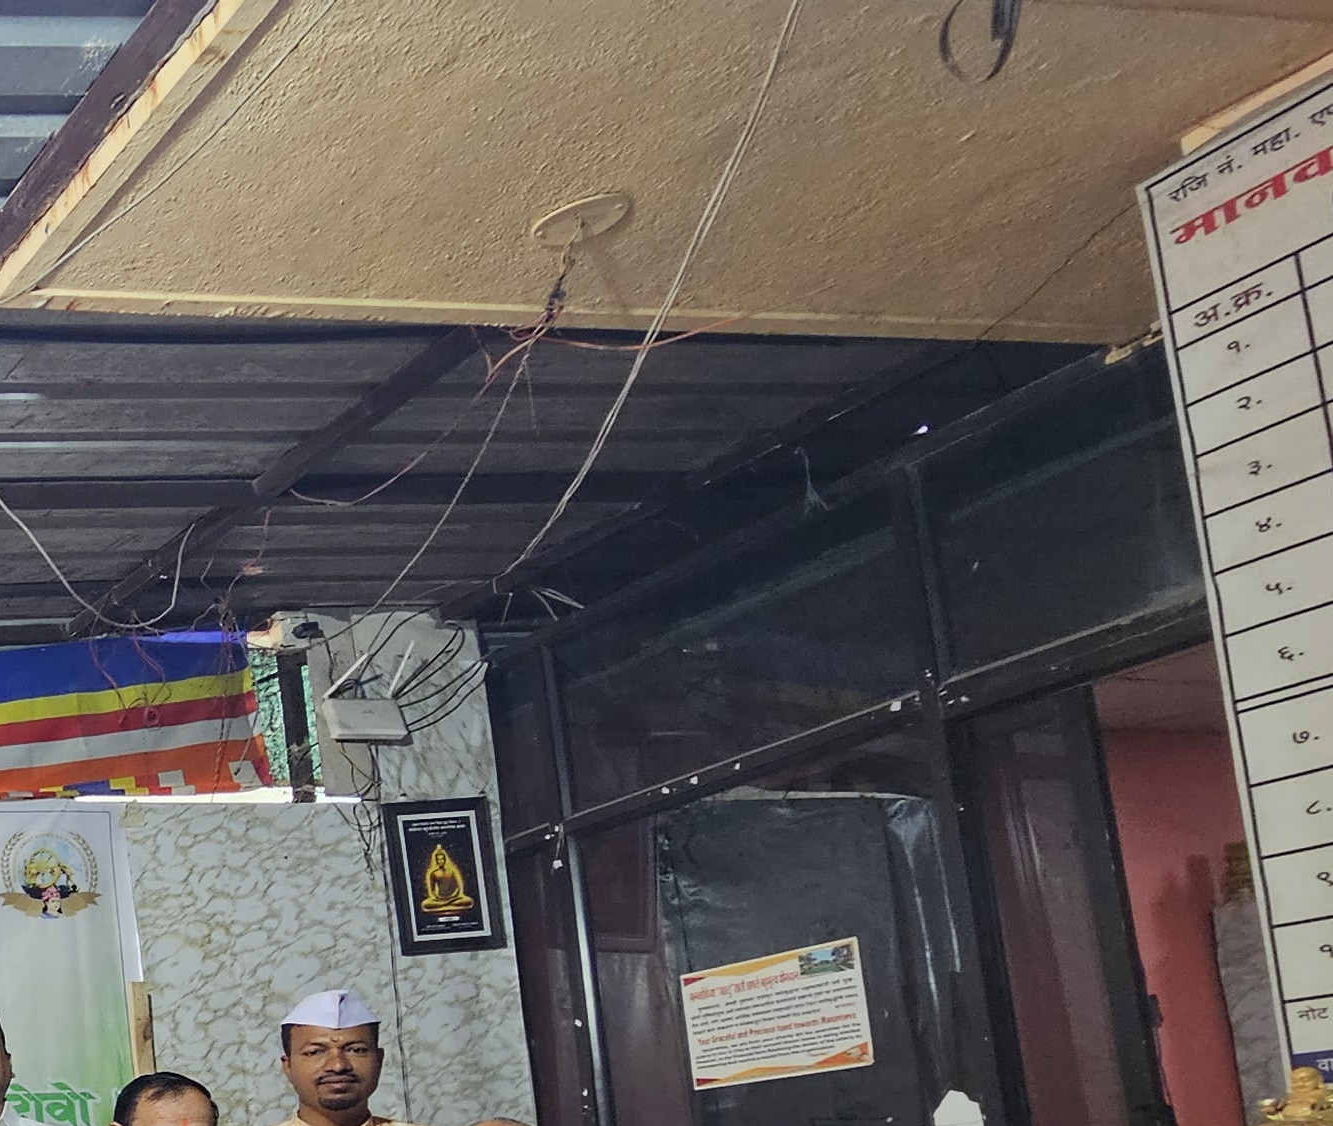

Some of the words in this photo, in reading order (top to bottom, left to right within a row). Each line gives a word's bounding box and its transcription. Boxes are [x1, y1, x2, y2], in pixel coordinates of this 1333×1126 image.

[1168, 176, 1208, 202] रजि
[1251, 127, 1300, 157] महा.
[1236, 395, 1263, 410] २.
[1248, 460, 1273, 476] ३.
[1255, 516, 1282, 533] ४.
[1265, 582, 1293, 595] ५.
